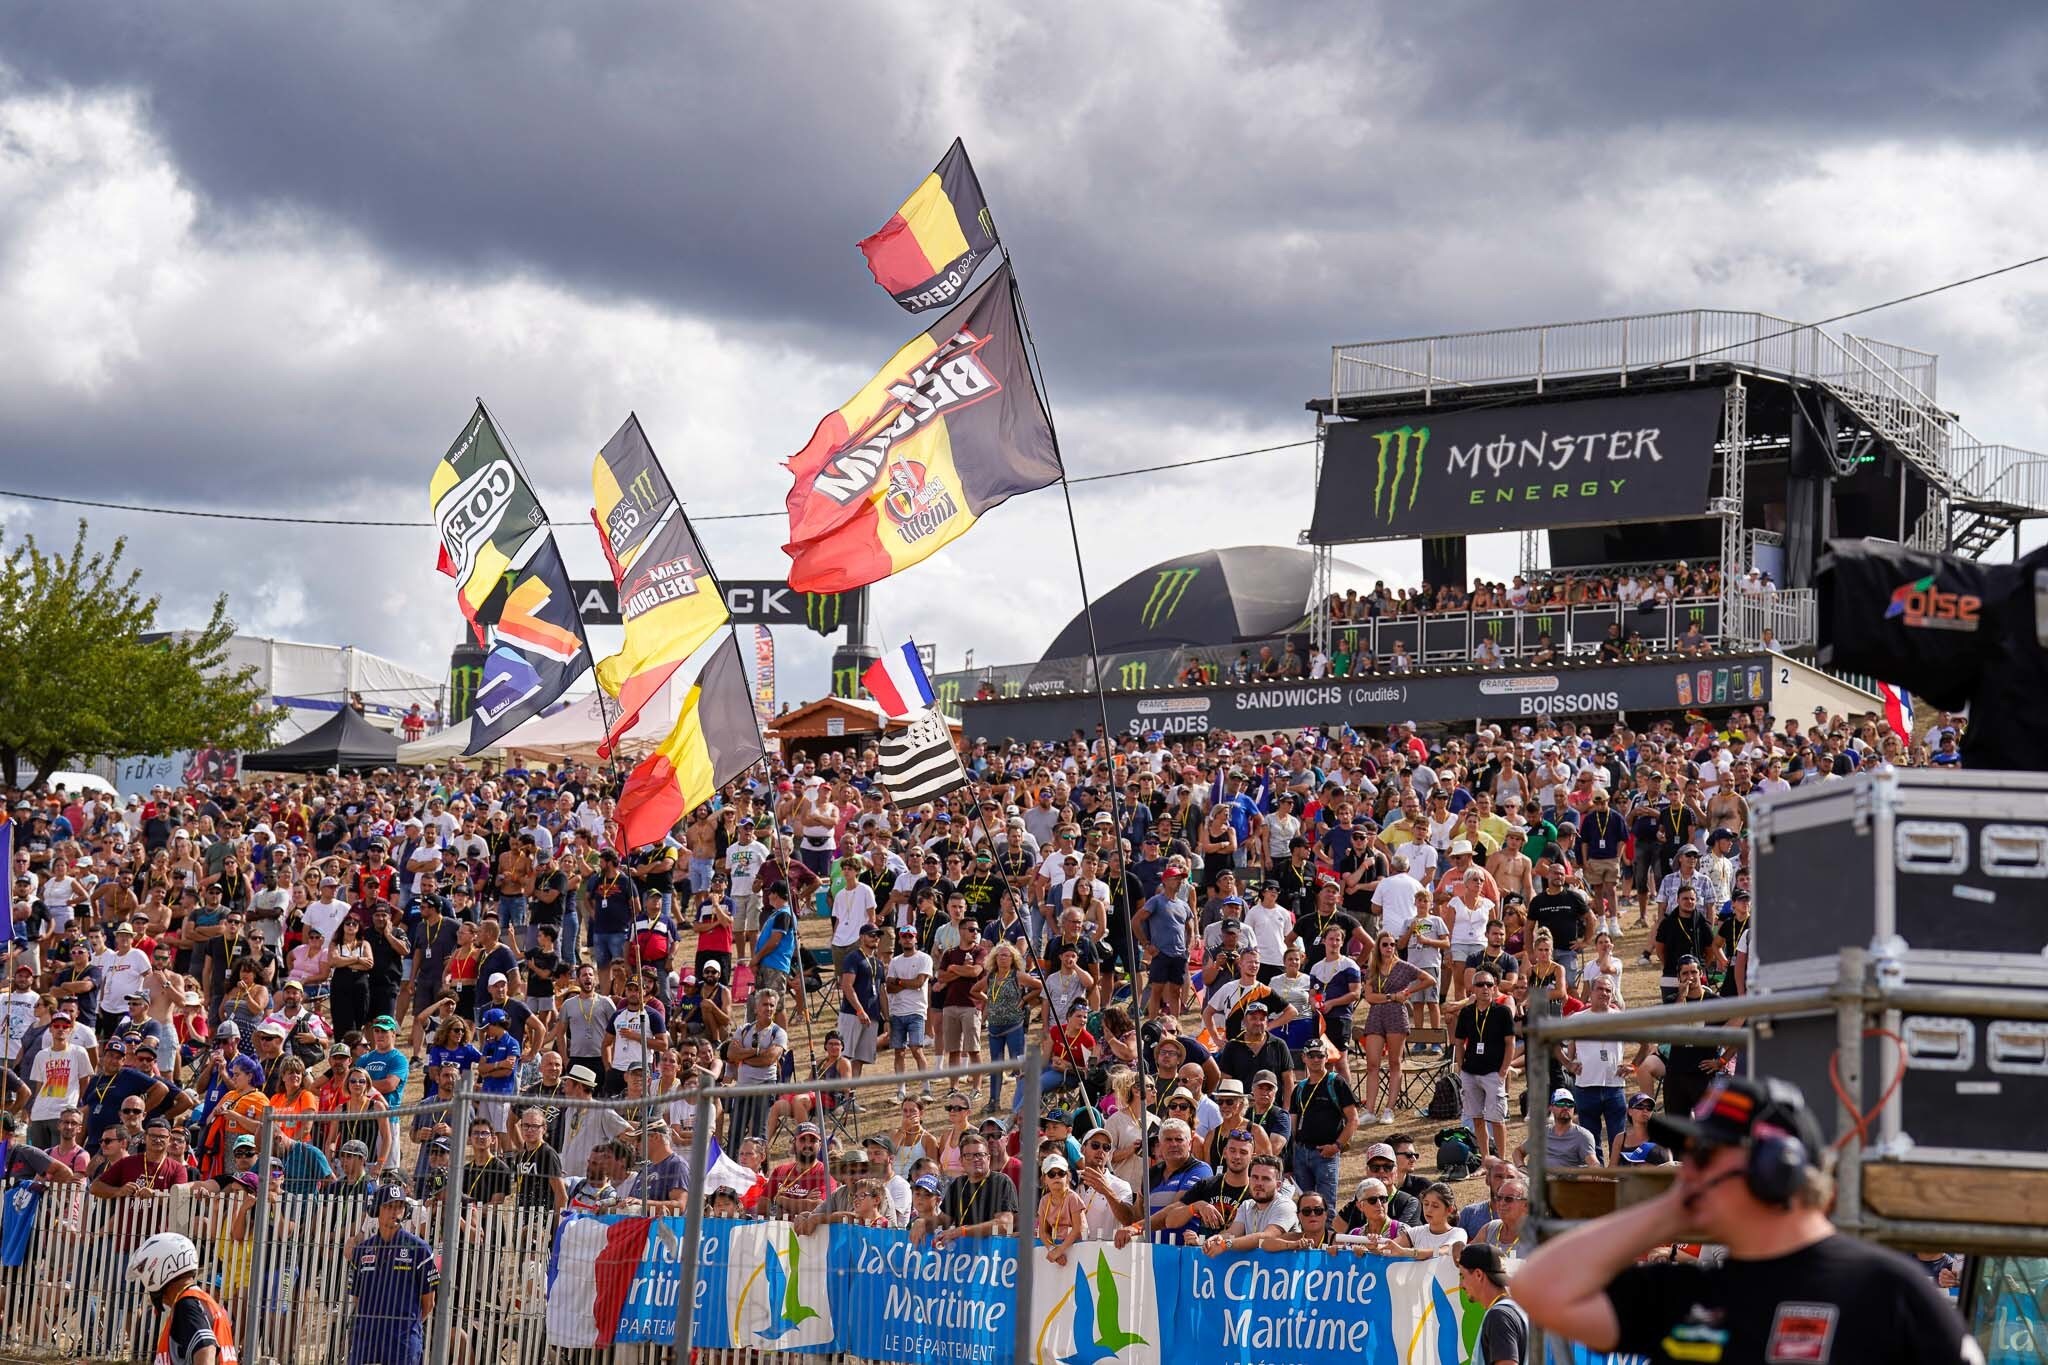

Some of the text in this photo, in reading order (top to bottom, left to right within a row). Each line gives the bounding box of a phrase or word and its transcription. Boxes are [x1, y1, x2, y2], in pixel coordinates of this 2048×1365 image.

[1446, 428, 1663, 478] MONSTER
[1470, 479, 1625, 504] ENERGY
[1781, 668, 1789, 684] 2
[1236, 686, 1342, 710] SANDWICHS
[1520, 692, 1619, 715] BOISSONS
[1129, 715, 1209, 736] SALADES
[125, 764, 156, 780] FOX
[1192, 1259, 1377, 1305] la Charente
[884, 1284, 1006, 1333] Maritime
[1222, 1308, 1369, 1354] Maritime
[884, 1334, 996, 1362] LE DÉPARTEMENT
